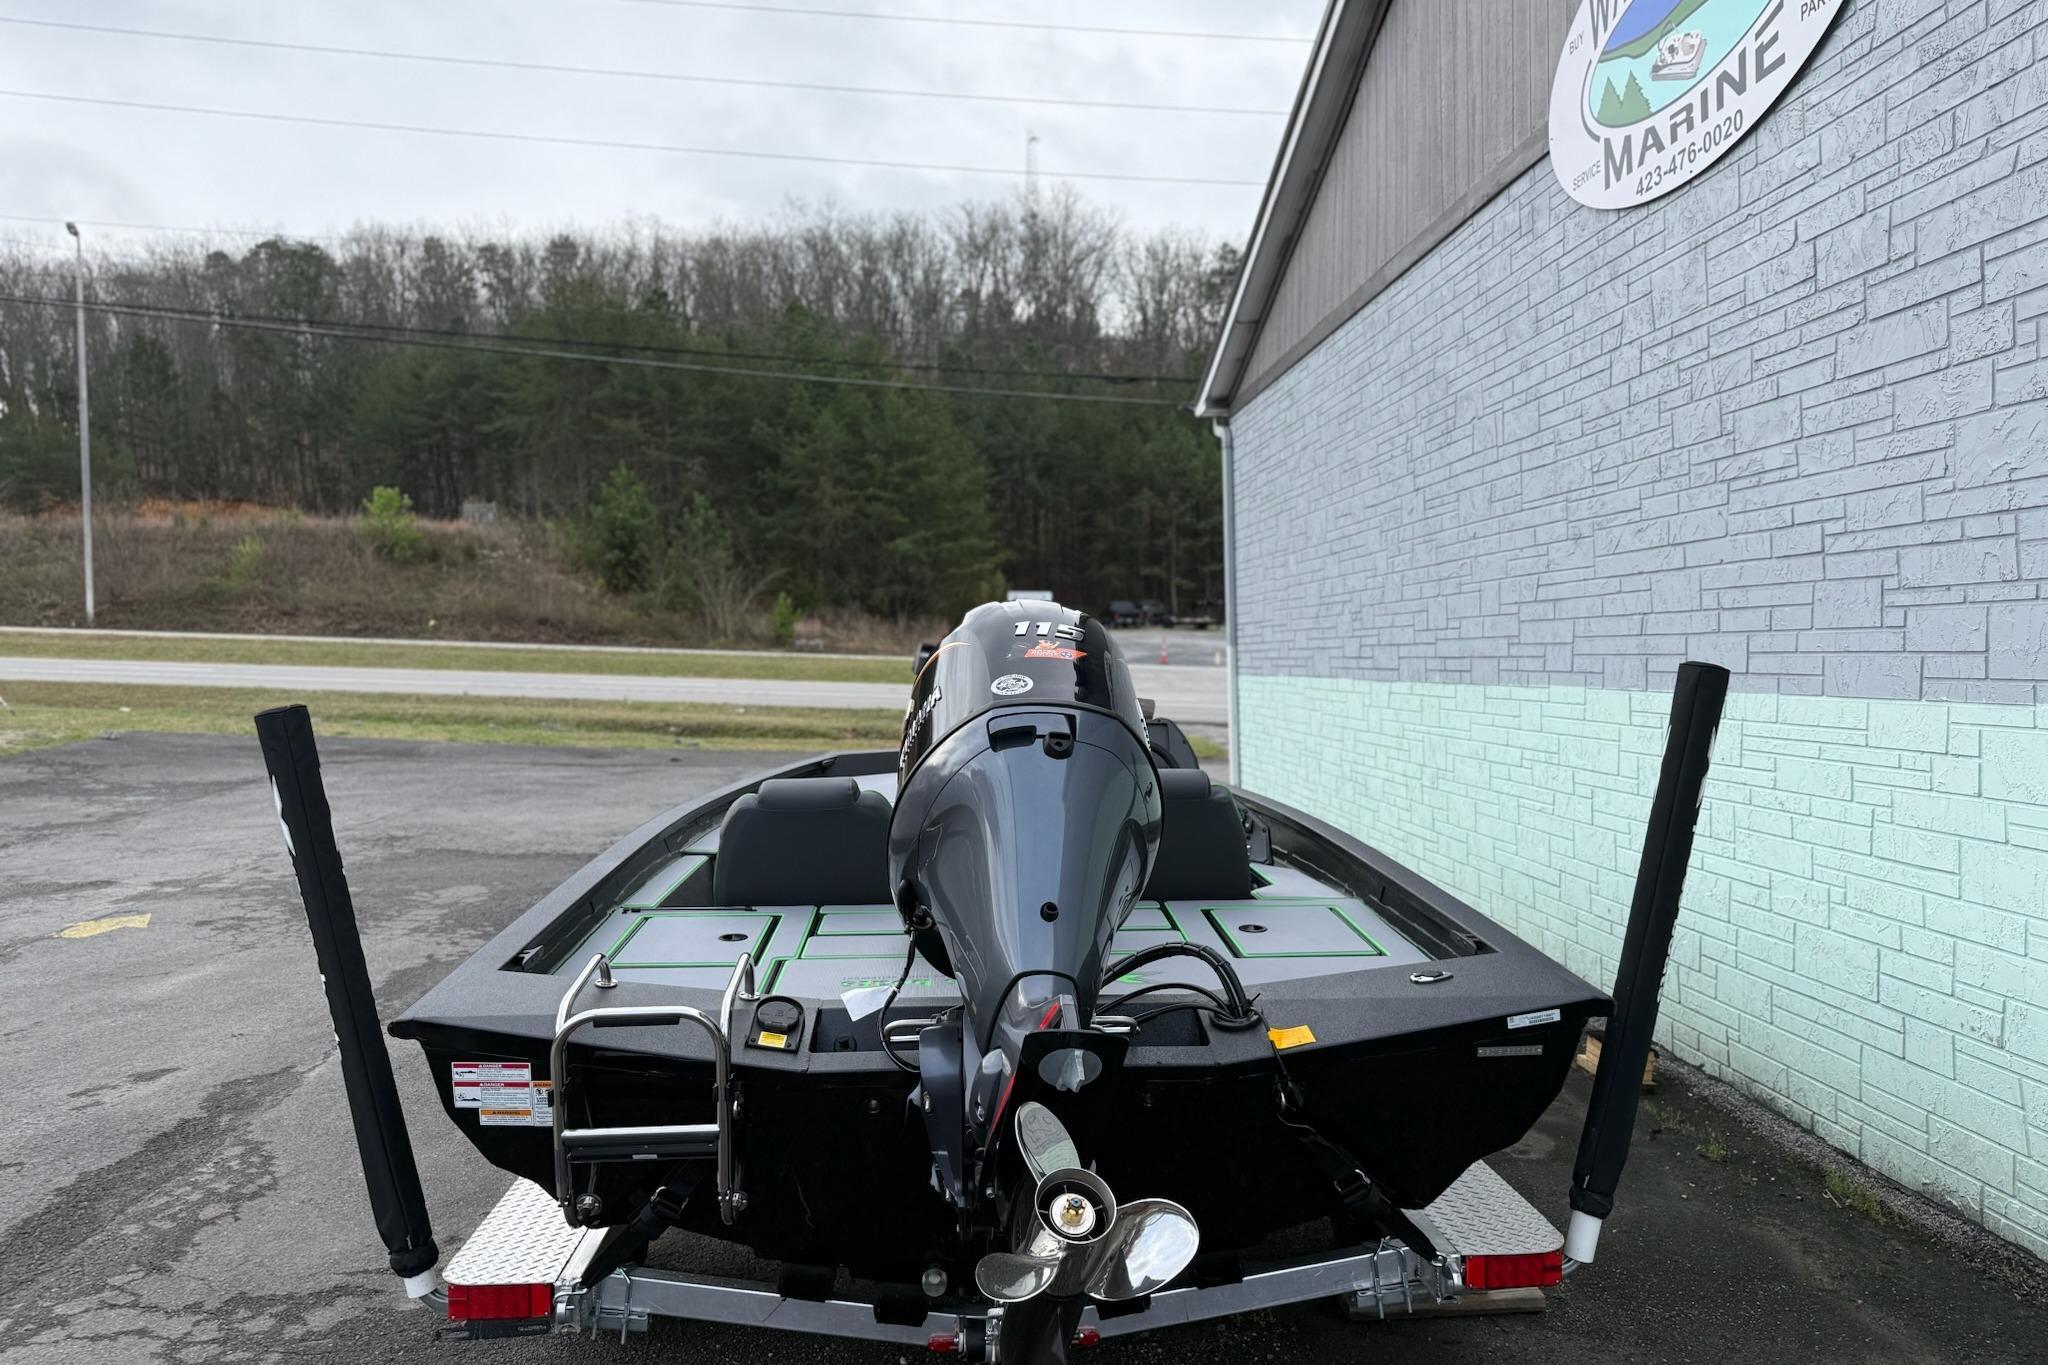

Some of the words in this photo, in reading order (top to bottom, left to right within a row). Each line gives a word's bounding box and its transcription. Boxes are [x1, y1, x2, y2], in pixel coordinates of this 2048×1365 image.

[1800, 0, 1832, 21] PAR
[1569, 30, 1584, 55] BUY
[1603, 0, 1786, 191] MARINE
[1635, 108, 1744, 197] 423-476-0020
[1572, 159, 1601, 191] SERVICE
[1014, 620, 1086, 642] 115
